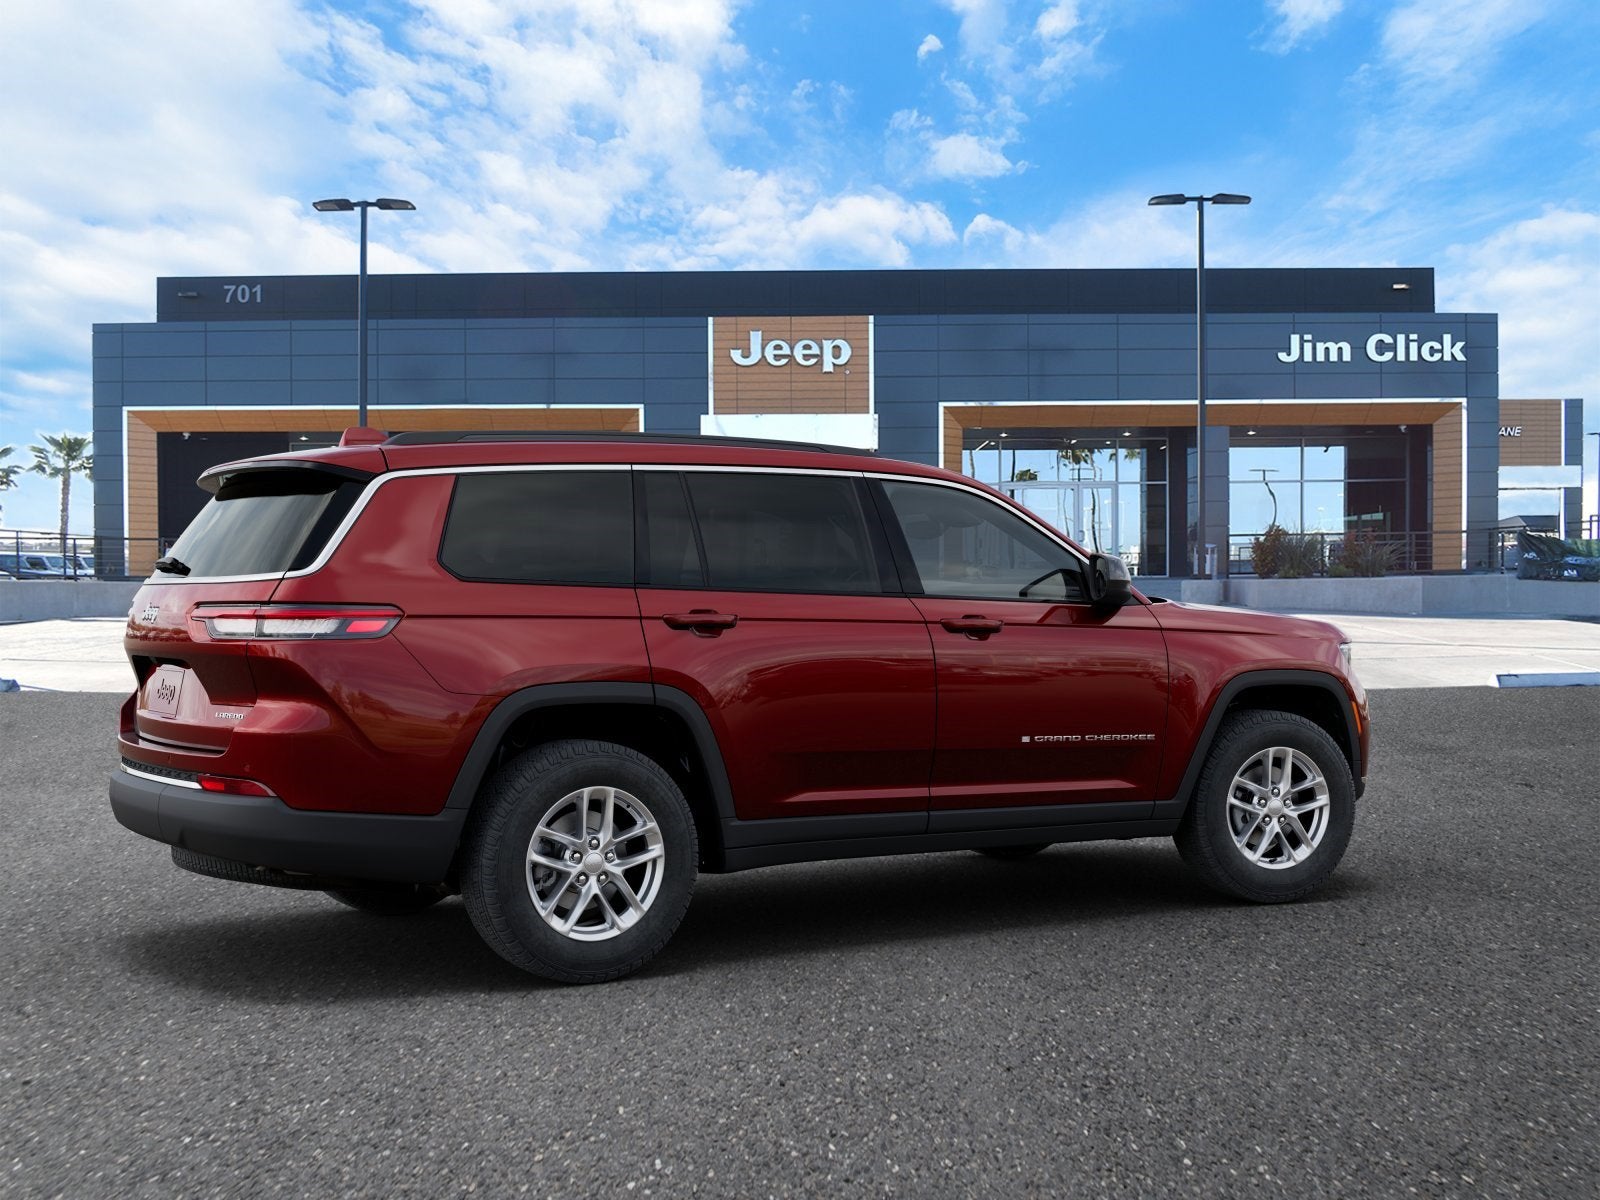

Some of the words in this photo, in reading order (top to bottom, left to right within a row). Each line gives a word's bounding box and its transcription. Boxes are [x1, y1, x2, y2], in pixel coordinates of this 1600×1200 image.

[223, 284, 262, 304] 701
[729, 330, 852, 373] Jeep
[1277, 333, 1352, 363] Jim
[1365, 333, 1467, 362] Click
[157, 678, 176, 705] Jeep
